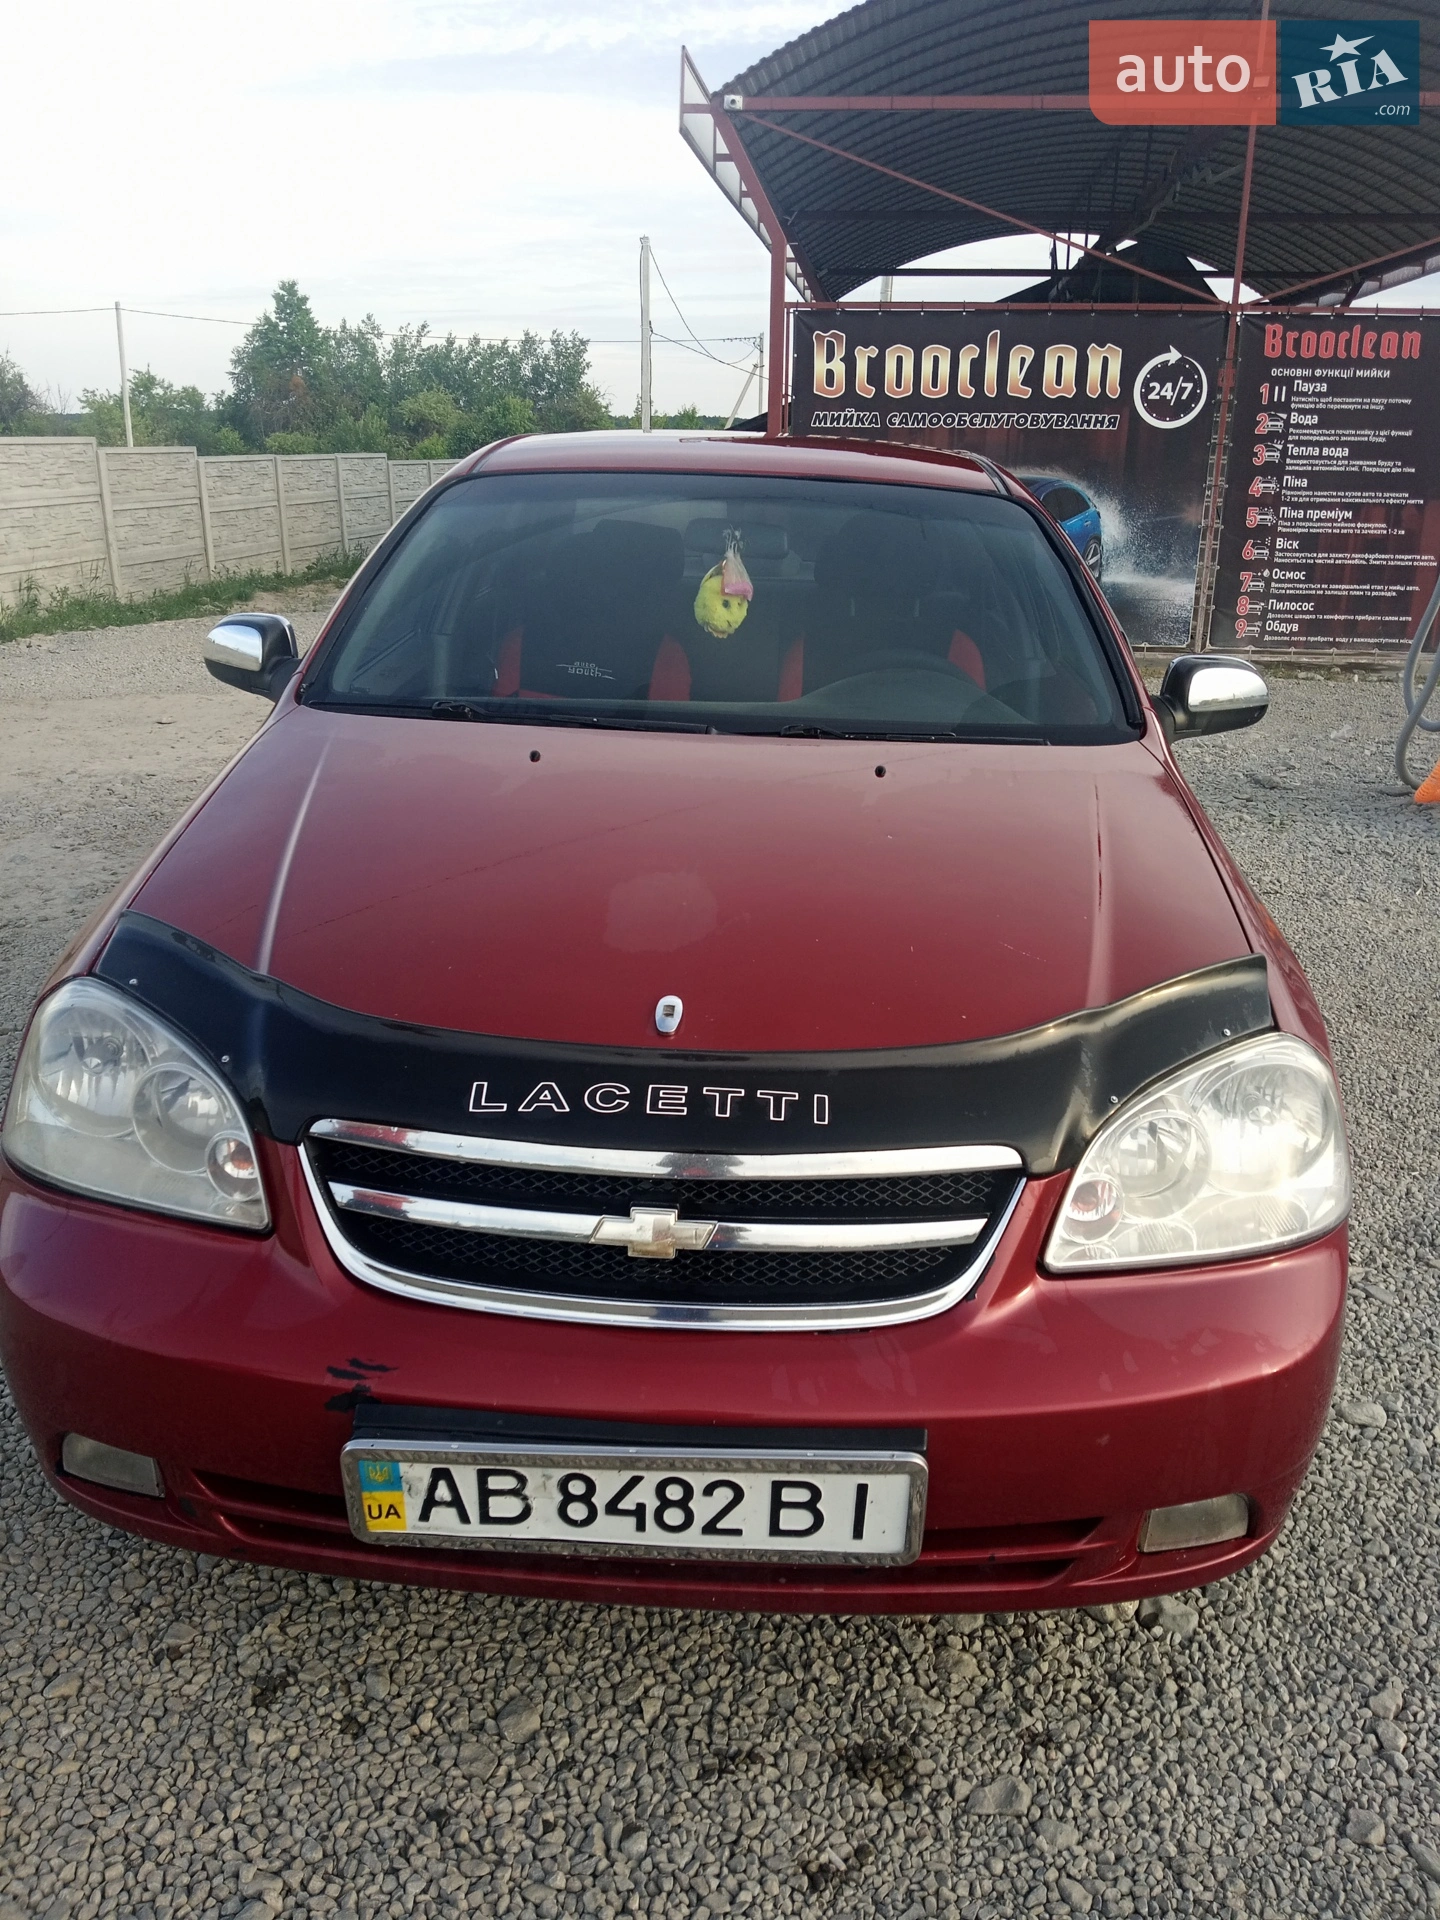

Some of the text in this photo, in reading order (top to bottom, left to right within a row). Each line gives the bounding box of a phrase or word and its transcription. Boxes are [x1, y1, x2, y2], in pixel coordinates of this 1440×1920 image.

[1263, 323, 1422, 359] Brooclean
[812, 329, 1122, 399] Brooclean
[1271, 367, 1391, 379] ОСНОВНІ ФУНКЦІЇ МИЙКИ
[1147, 376, 1194, 406] 24/7
[1259, 379, 1327, 405] 1 Пауза
[811, 408, 1120, 430] МИЙКА САМООБСЛУГОВУВАННЯ
[1255, 412, 1318, 434] 2 Вода
[1253, 444, 1349, 466] 3 Тепла вода
[1249, 475, 1308, 497] 4 Піна
[1246, 507, 1353, 528] 5 Піна преміум
[1242, 538, 1300, 560] 6 Віск
[1240, 568, 1306, 593] 7 Осмос
[1237, 596, 1315, 616] 8 Пилосос
[1235, 619, 1299, 639] 9 Обдув
[469, 1082, 829, 1124] LACETTI
[367, 1503, 402, 1520] UA
[418, 1467, 533, 1525] AB
[556, 1472, 746, 1537] 8482
